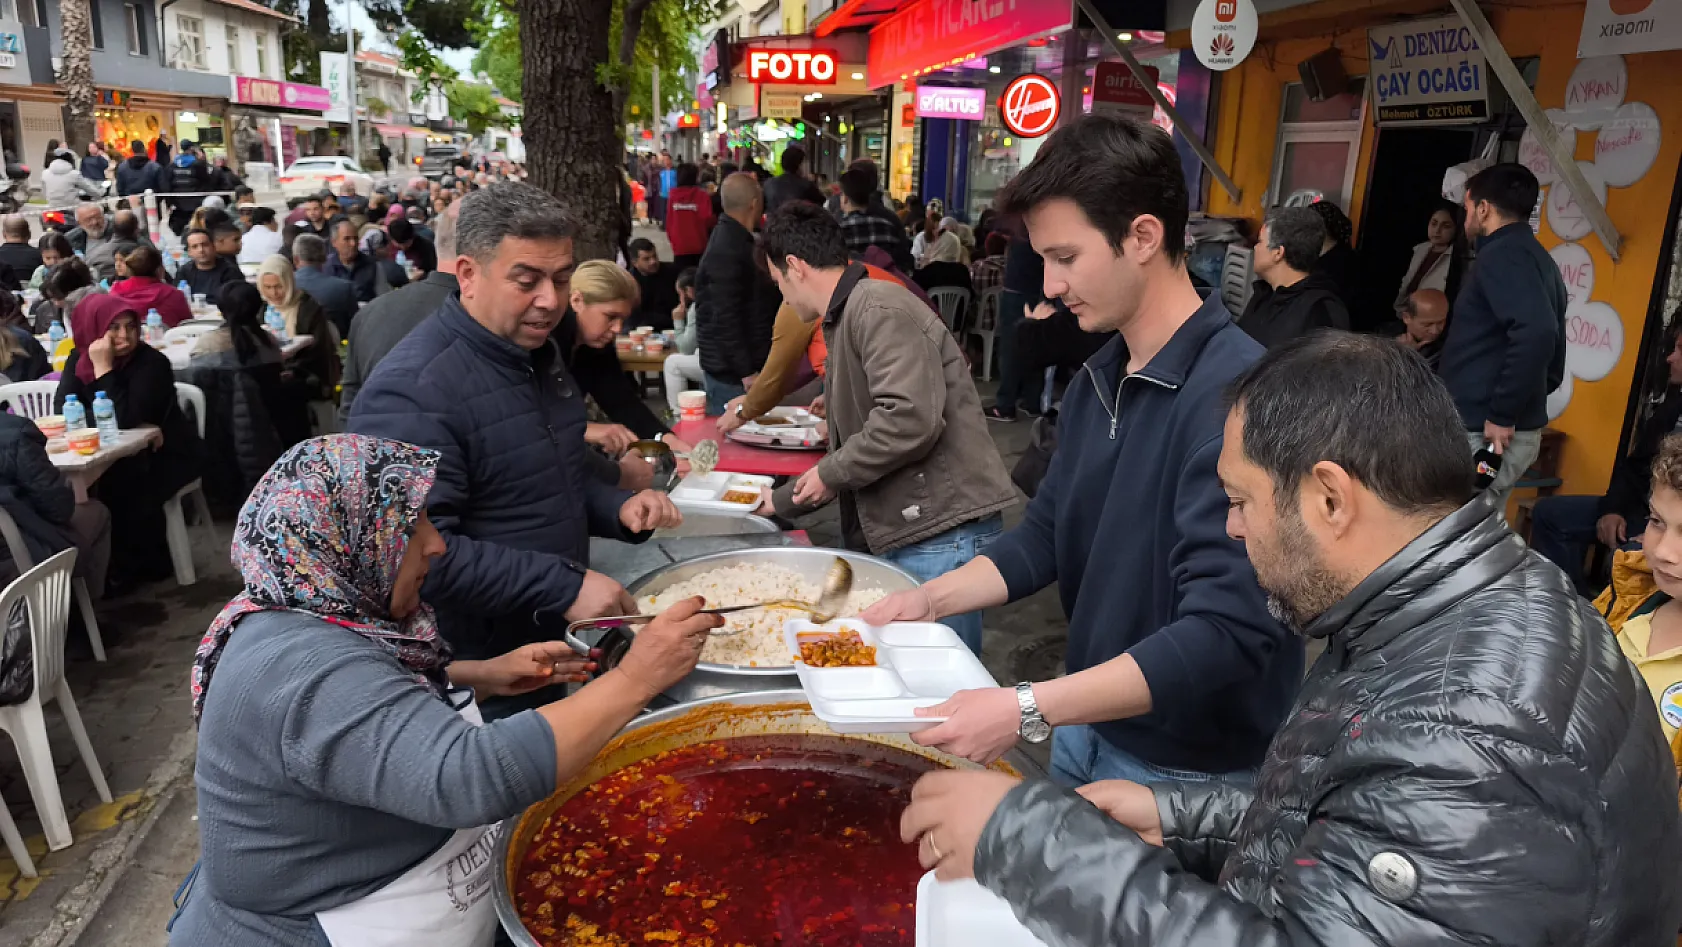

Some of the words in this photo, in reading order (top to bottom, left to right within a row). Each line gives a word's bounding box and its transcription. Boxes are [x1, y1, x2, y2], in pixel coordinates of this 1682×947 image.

[881, 10, 925, 62] ATLAS
[1599, 18, 1656, 38] xiaomi
[751, 52, 834, 80] FOTO
[1377, 71, 1411, 102] ÇAY
[1418, 60, 1480, 95] OCAĞI
[934, 96, 980, 114] ALTUS
[1427, 104, 1473, 118] ÖZTÜRK
